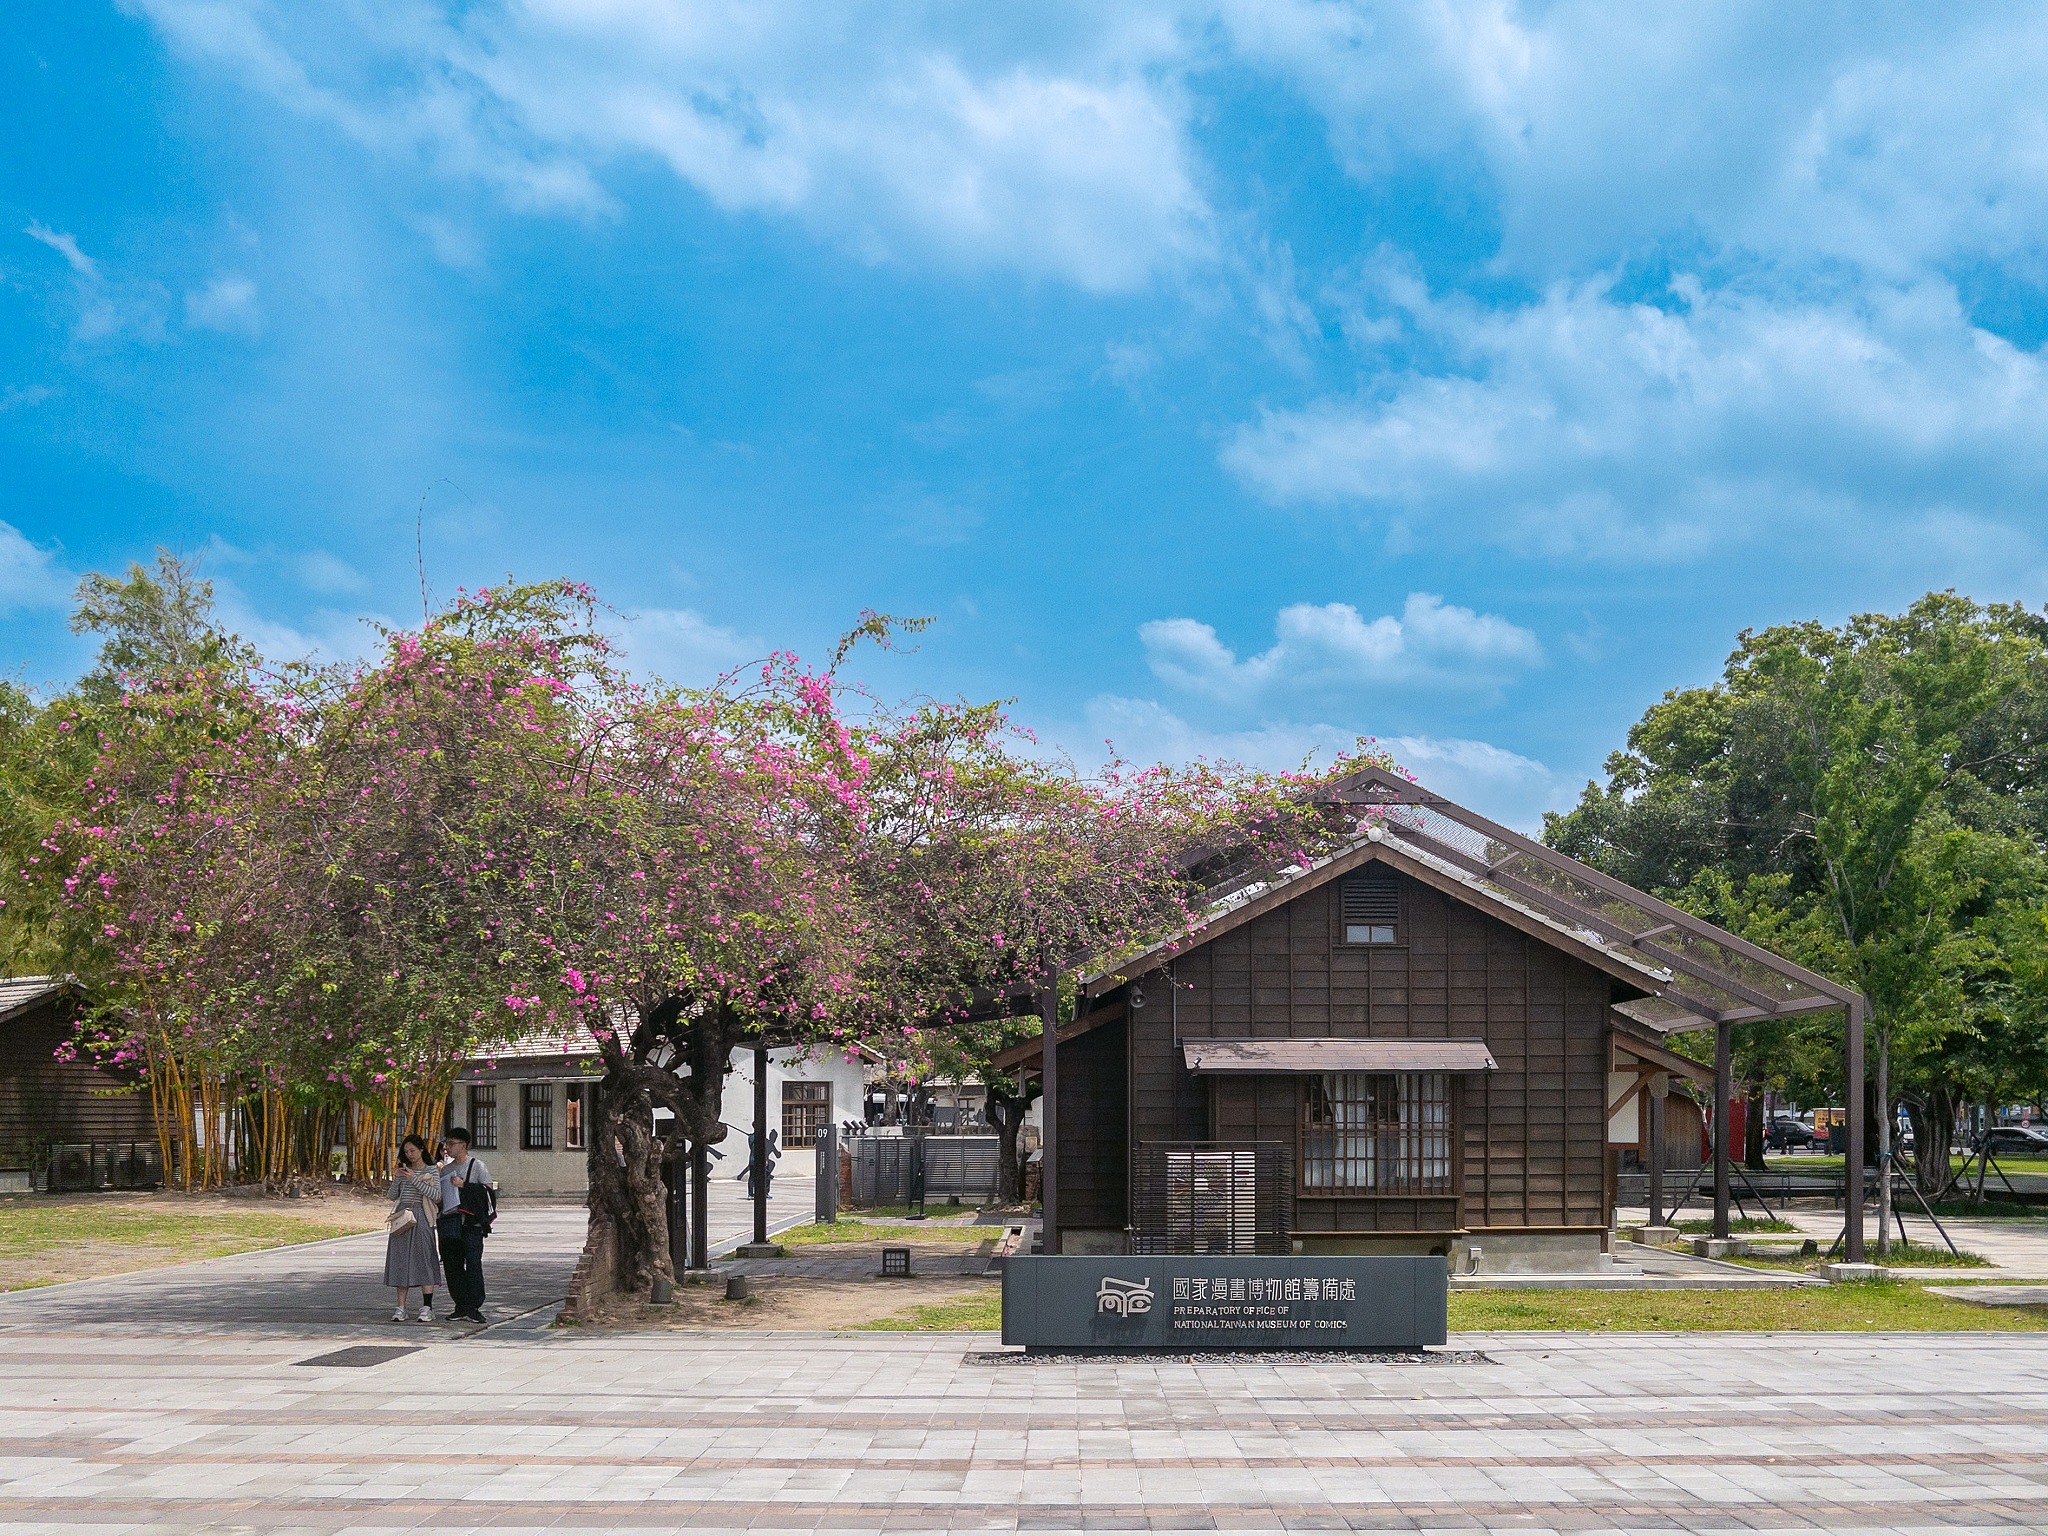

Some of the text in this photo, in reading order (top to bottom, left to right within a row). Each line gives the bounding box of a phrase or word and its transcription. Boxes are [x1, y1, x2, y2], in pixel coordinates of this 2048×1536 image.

[817, 1128, 828, 1138] 09
[1173, 1277, 1356, 1301] 國家漫畫博物館籌備處
[1173, 1306, 1289, 1316] PREPARATORY OFFICE OF
[1256, 1320, 1298, 1329] MUSEUM
[1299, 1320, 1311, 1329] OF
[1314, 1320, 1348, 1329] COMICS
